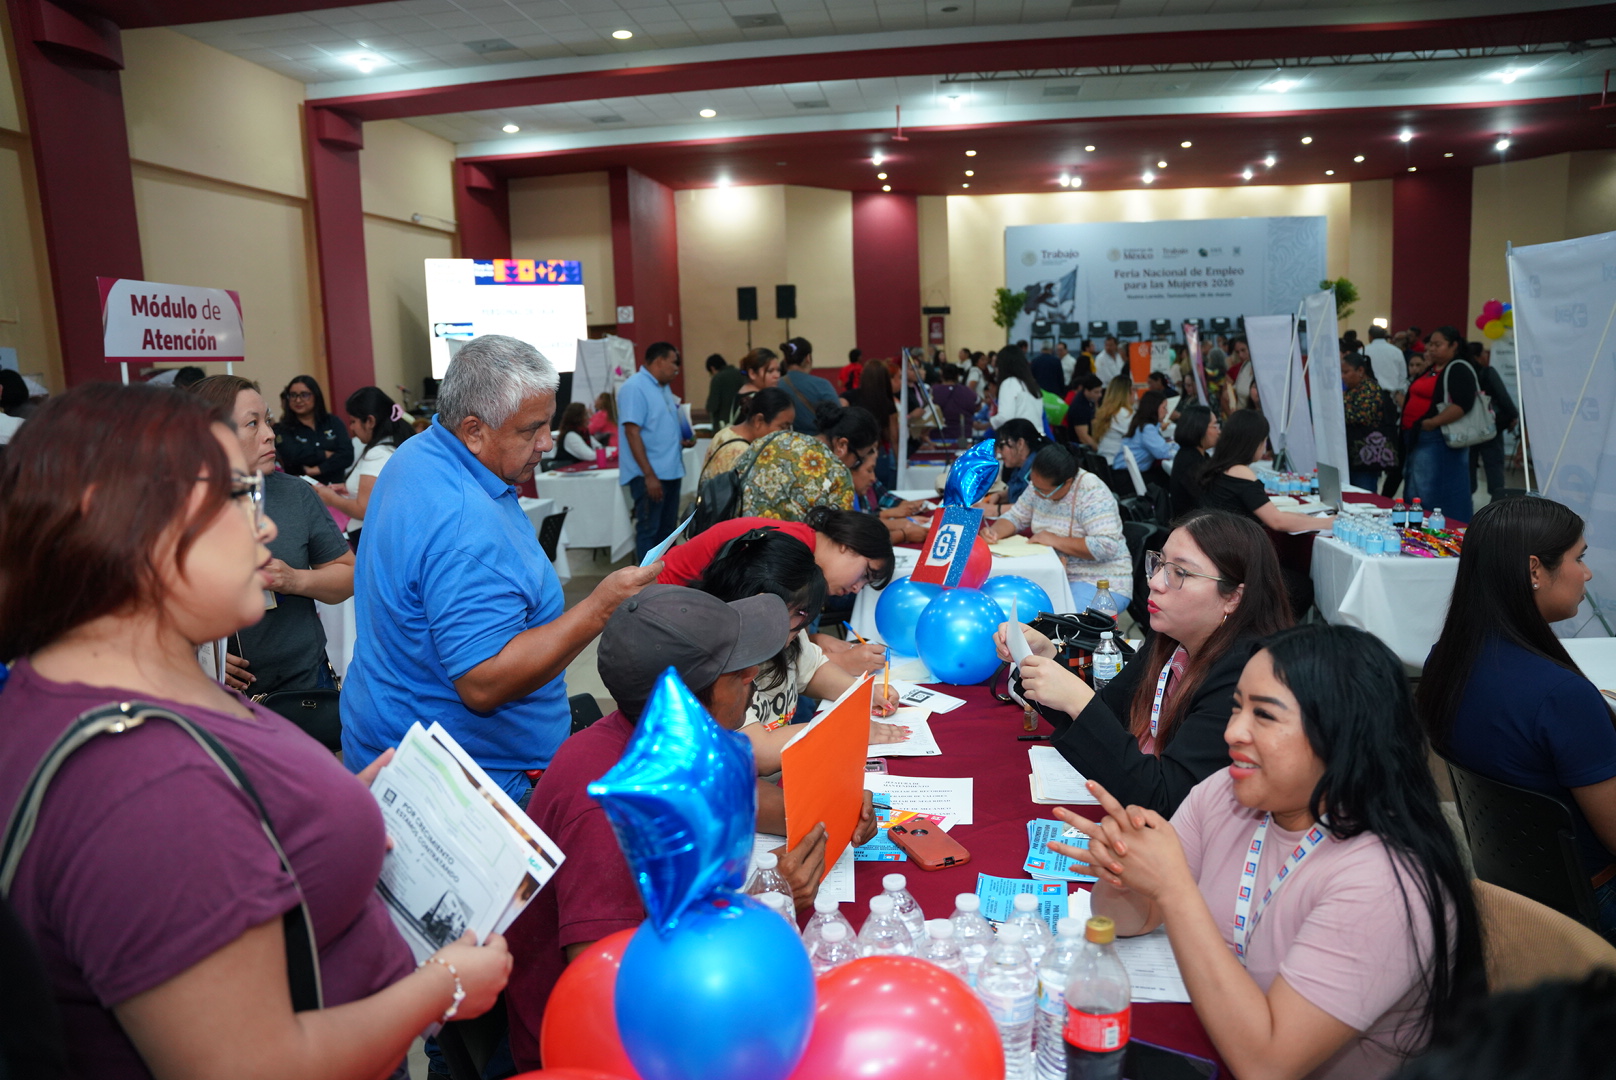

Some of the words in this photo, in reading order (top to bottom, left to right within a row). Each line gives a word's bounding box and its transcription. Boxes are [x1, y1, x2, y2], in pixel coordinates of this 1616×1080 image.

[1041, 249, 1079, 259] Trabajo
[1114, 269, 1140, 279] Feria
[1142, 267, 1187, 278] Nacional
[1190, 267, 1202, 276] de
[1205, 266, 1244, 278] Empleo
[1123, 281, 1147, 291] para
[1150, 280, 1164, 289] las
[1167, 279, 1208, 290] Mujeres
[1212, 278, 1234, 288] 2026
[130, 294, 197, 319] Módulo
[202, 298, 221, 320] de
[142, 328, 217, 350] Atención
[402, 801, 416, 818] POR
[415, 816, 456, 866] CRECIMIENTO
[418, 838, 461, 884] CONTRATANDO
